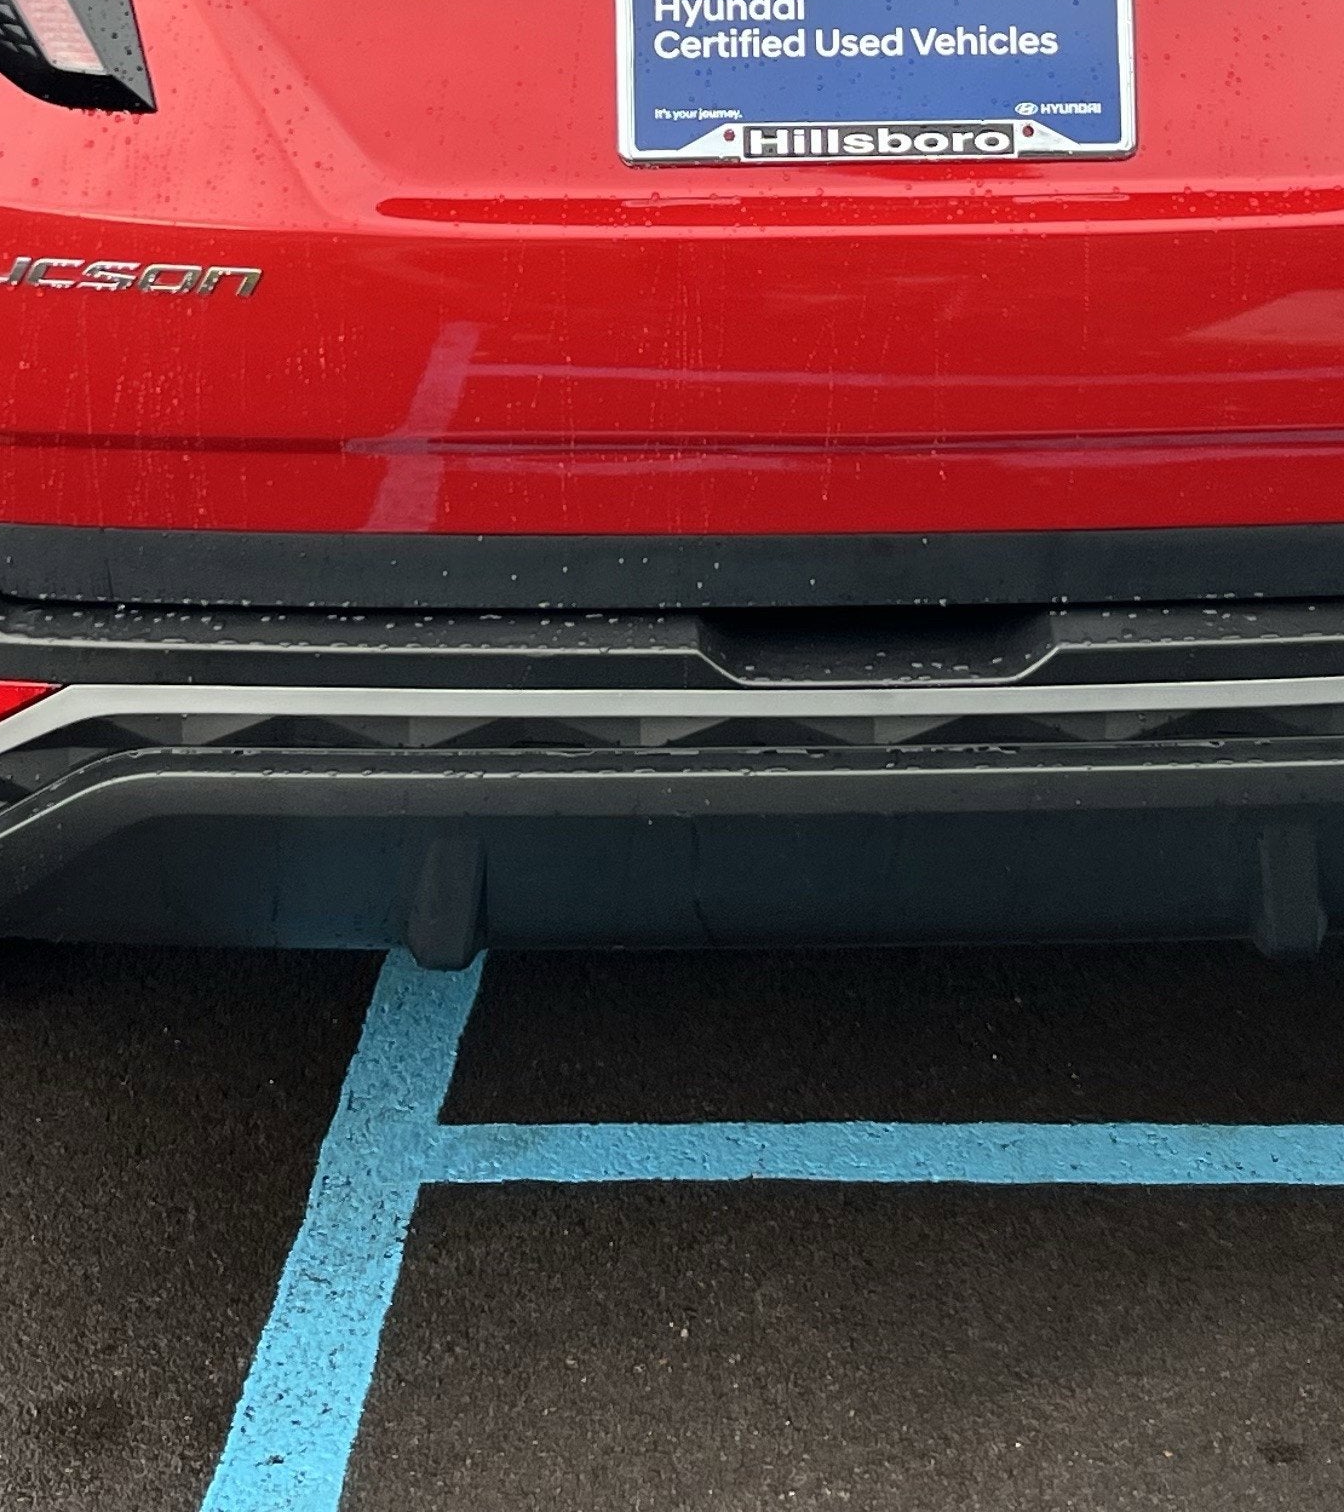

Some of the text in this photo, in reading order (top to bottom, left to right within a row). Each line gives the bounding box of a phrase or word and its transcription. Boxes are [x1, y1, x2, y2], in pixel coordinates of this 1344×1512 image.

[654, 25, 1058, 60] Certified Used Vehicles
[672, 109, 697, 121] your
[1040, 102, 1102, 115] HYUNDAI
[749, 128, 1011, 155] Hillsboro
